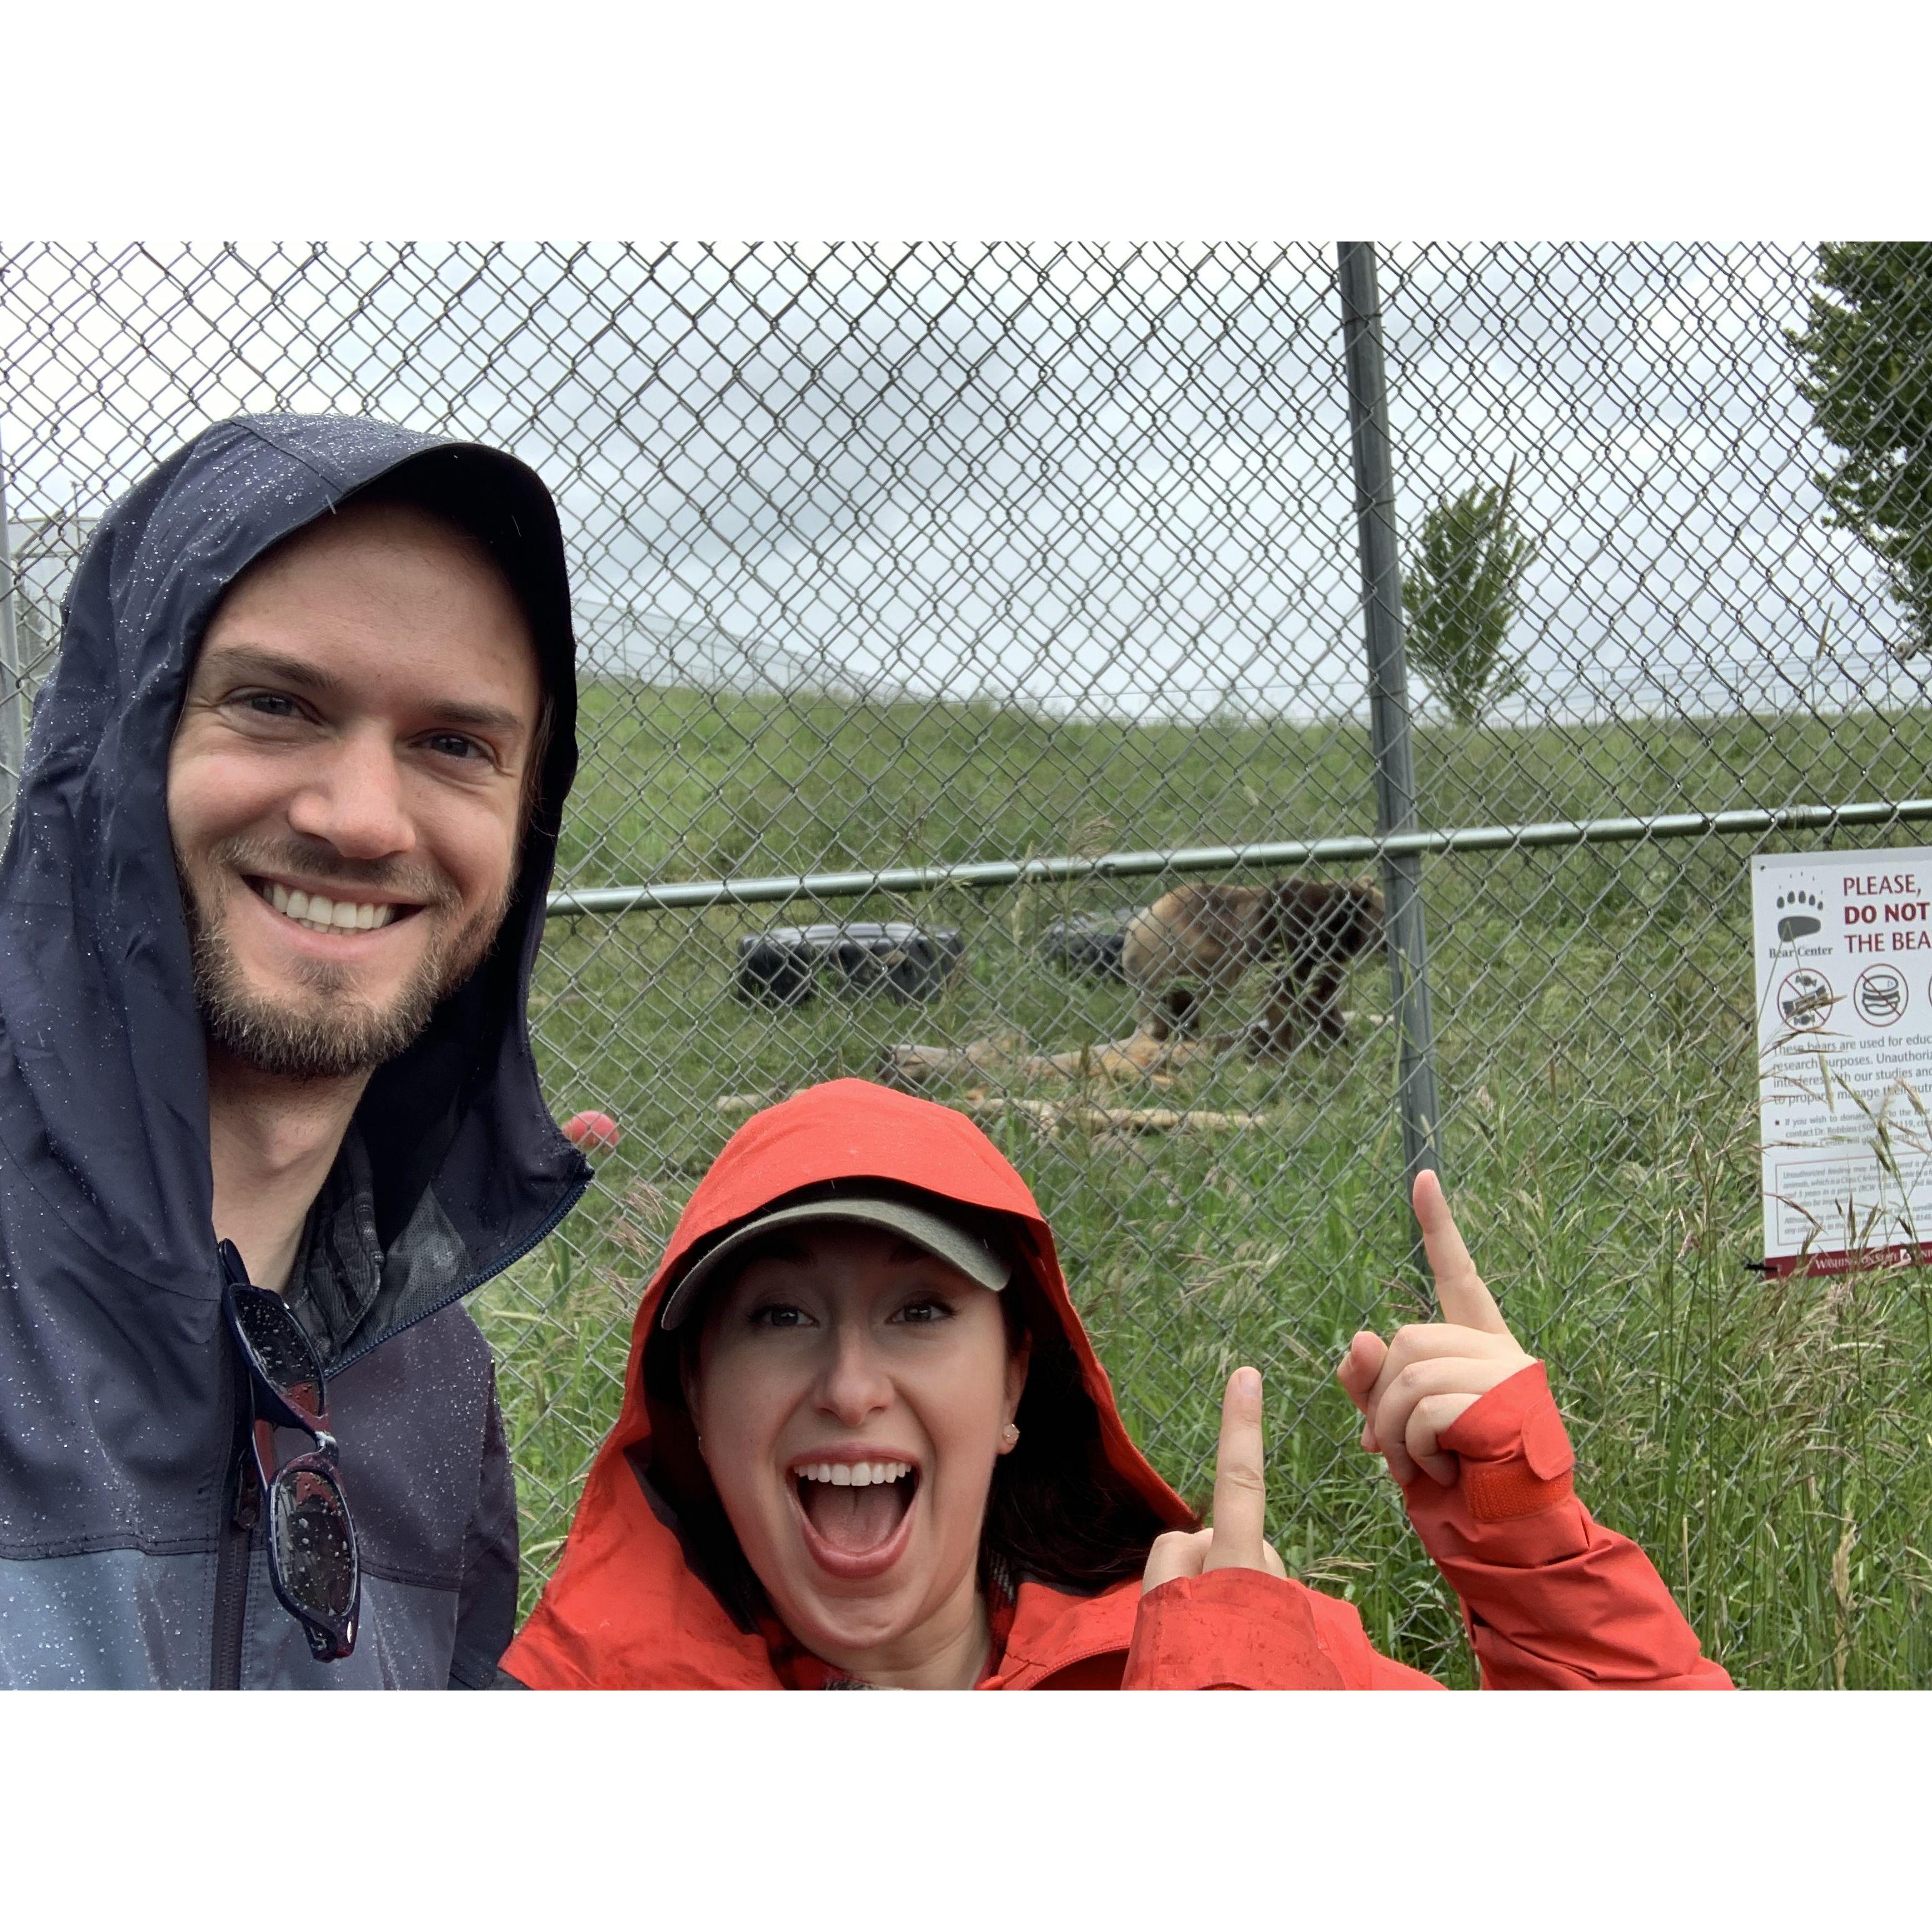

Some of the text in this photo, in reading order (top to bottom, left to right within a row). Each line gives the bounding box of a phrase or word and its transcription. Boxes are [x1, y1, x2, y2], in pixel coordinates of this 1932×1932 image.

[1843, 874, 1922, 898] PLEASE,
[1844, 902, 1931, 925] DO NOT
[1843, 932, 1886, 953] THE
[1797, 945, 1833, 957] Center
[1839, 1040, 1856, 1050] are
[1859, 1036, 1885, 1049] used
[1888, 1035, 1903, 1047] for
[1773, 1057, 1818, 1071] research
[1822, 1054, 1874, 1070] urposes.
[1854, 1072, 1873, 1082] our
[1876, 1067, 1913, 1080] studies
[1809, 1115, 1827, 1124] wish
[1786, 1129, 1813, 1138] contact
